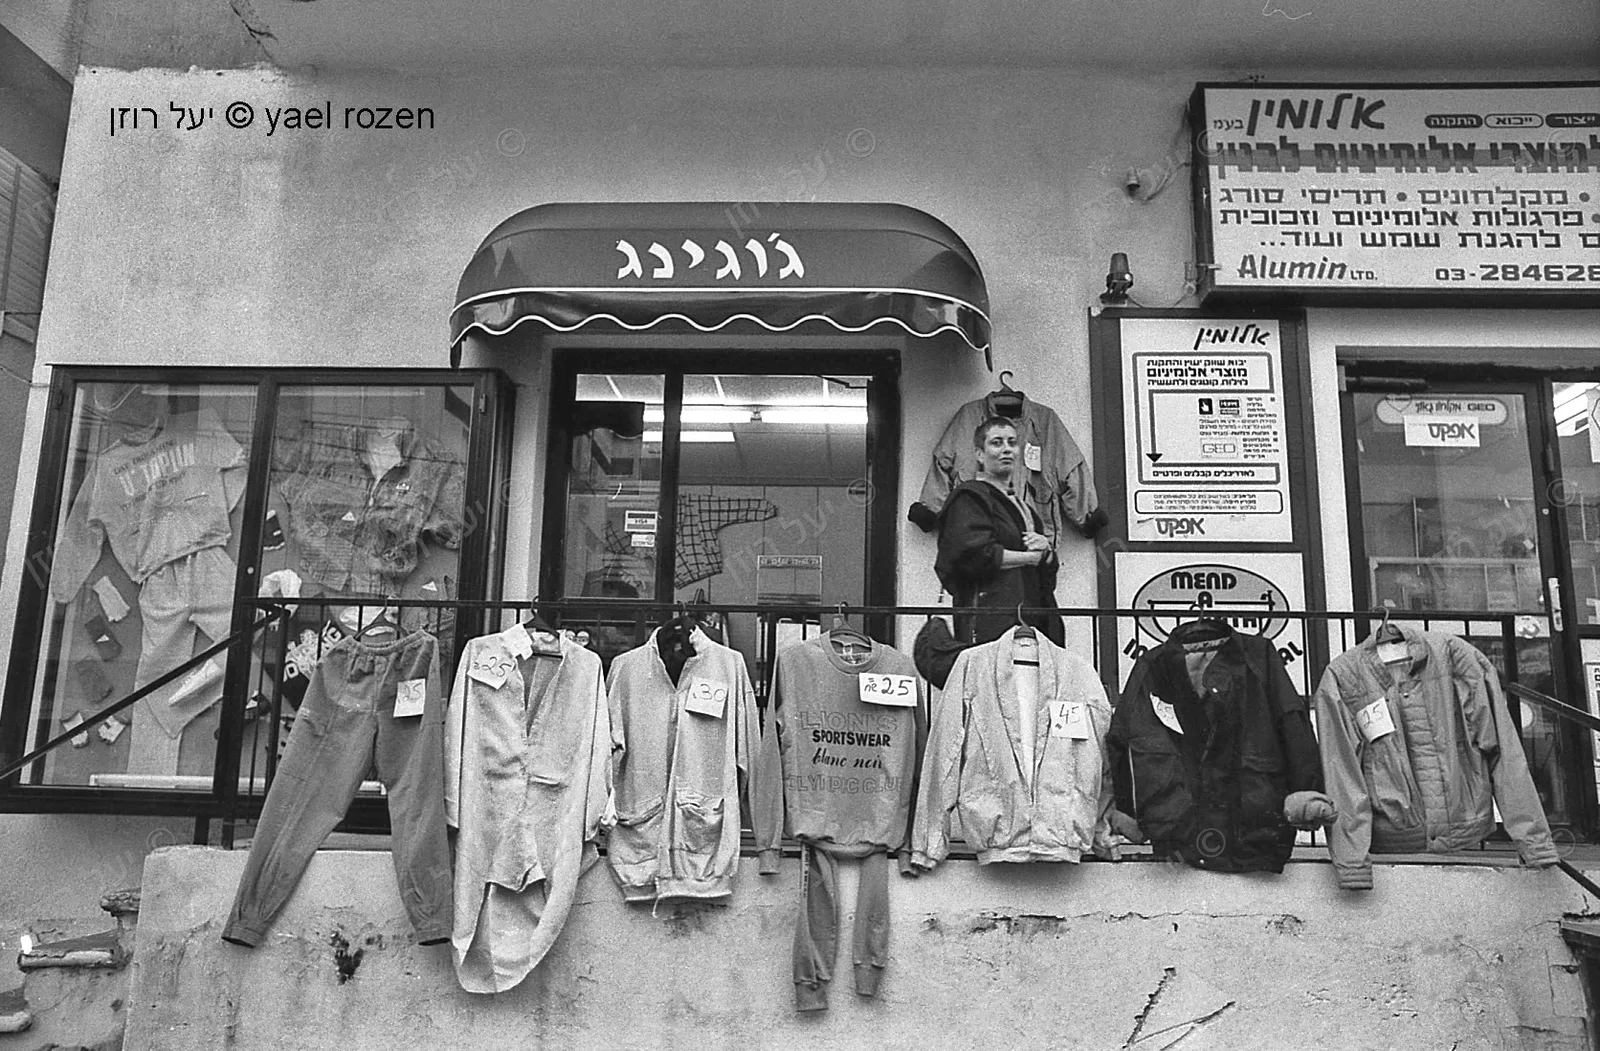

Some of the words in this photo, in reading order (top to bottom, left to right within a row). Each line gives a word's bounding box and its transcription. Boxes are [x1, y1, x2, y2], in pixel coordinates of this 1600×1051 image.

[1247, 92, 1386, 136] אלומין
[1430, 116, 1477, 127] התקנה
[1314, 135, 1478, 173] אלומיניום
[1219, 188, 1284, 203] סורג
[1301, 188, 1386, 204] תריסי
[1417, 186, 1569, 208] מקלחונים
[1220, 209, 1319, 226] וזכוכית
[1332, 207, 1459, 226] אלומיניום
[1472, 207, 1583, 226] פרגולות
[1360, 232, 1441, 248] שמש
[1458, 229, 1561, 248] להגנת
[1237, 254, 1348, 279] Alumin
[1350, 270, 1378, 281] LTD.
[1193, 323, 1270, 350] אלומין
[1147, 366, 1207, 377] אלומיניום
[1209, 368, 1247, 377] מוצרי
[1170, 572, 1237, 589] MEND
[1198, 591, 1213, 608] A
[881, 676, 913, 696] 25
[800, 710, 898, 733] LION'S
[1059, 703, 1079, 724] 45
[812, 729, 891, 747] SPORTSWEAR
[812, 748, 847, 767] blanc
